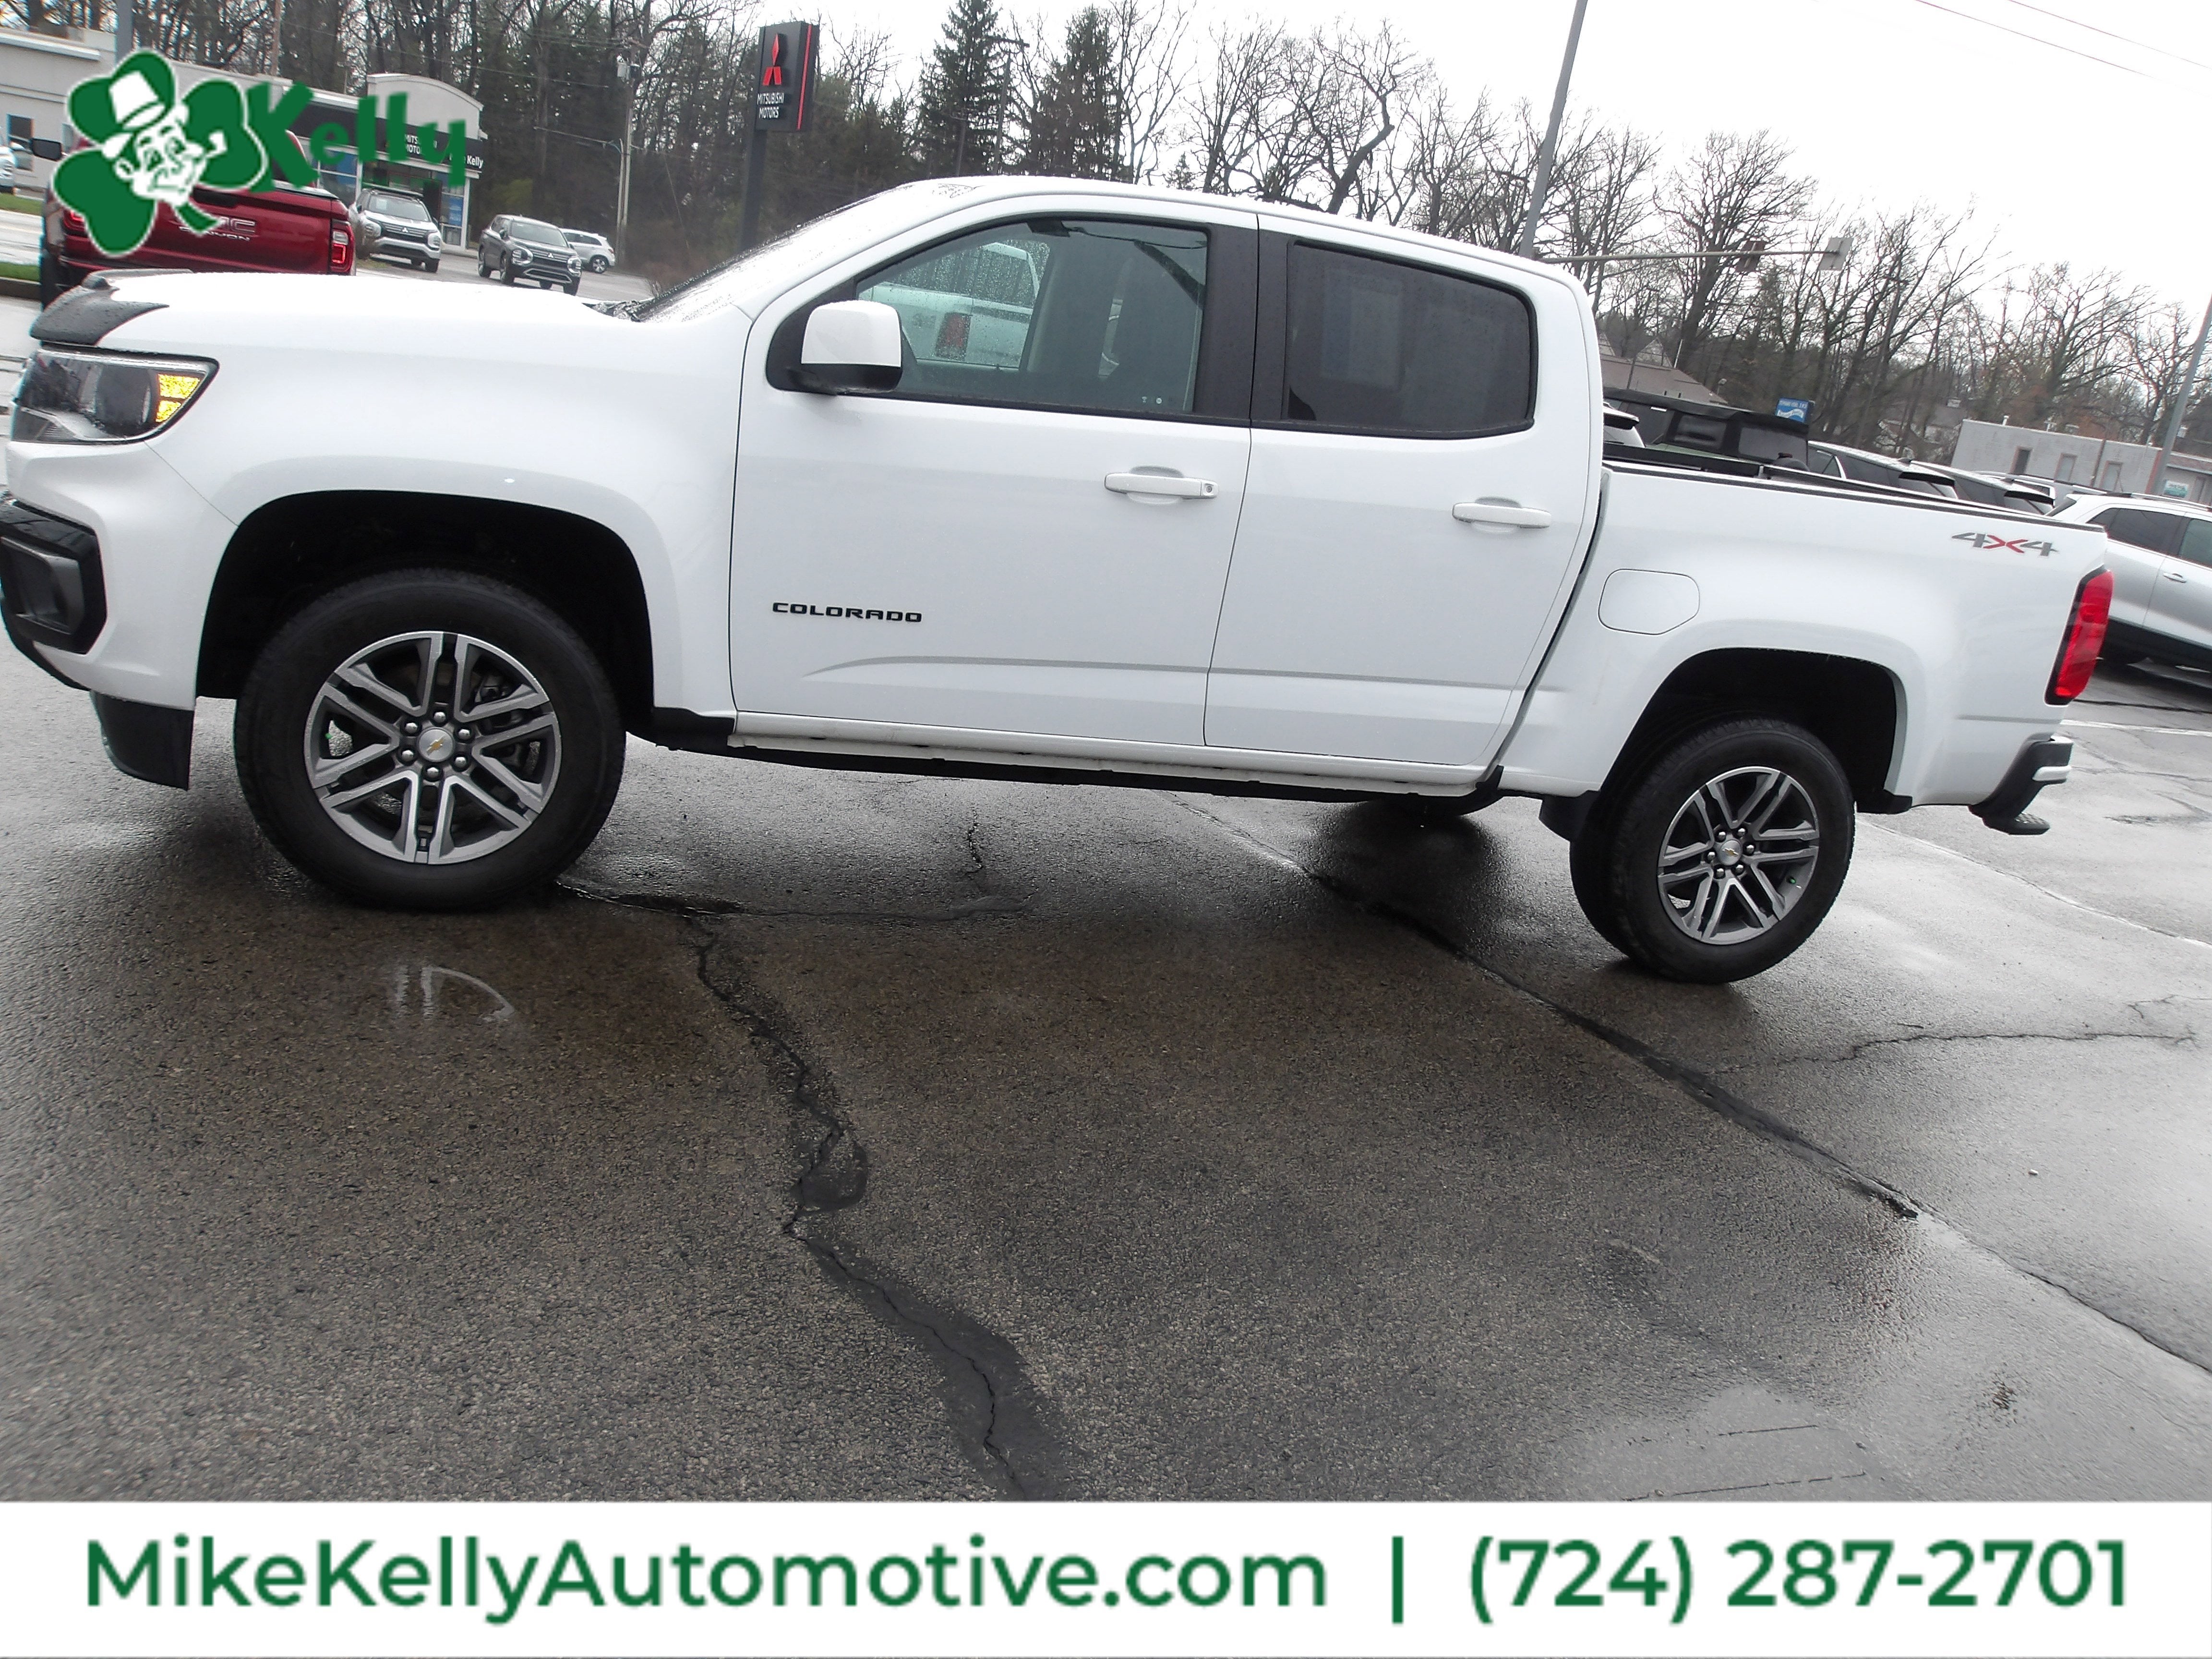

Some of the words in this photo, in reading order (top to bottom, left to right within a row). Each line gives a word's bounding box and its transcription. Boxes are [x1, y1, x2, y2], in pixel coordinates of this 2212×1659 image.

[757, 92, 784, 105] MITSUBISHI
[759, 106, 780, 119] MOTORS
[467, 155, 483, 169] Kelly
[772, 601, 923, 623] COLORADO
